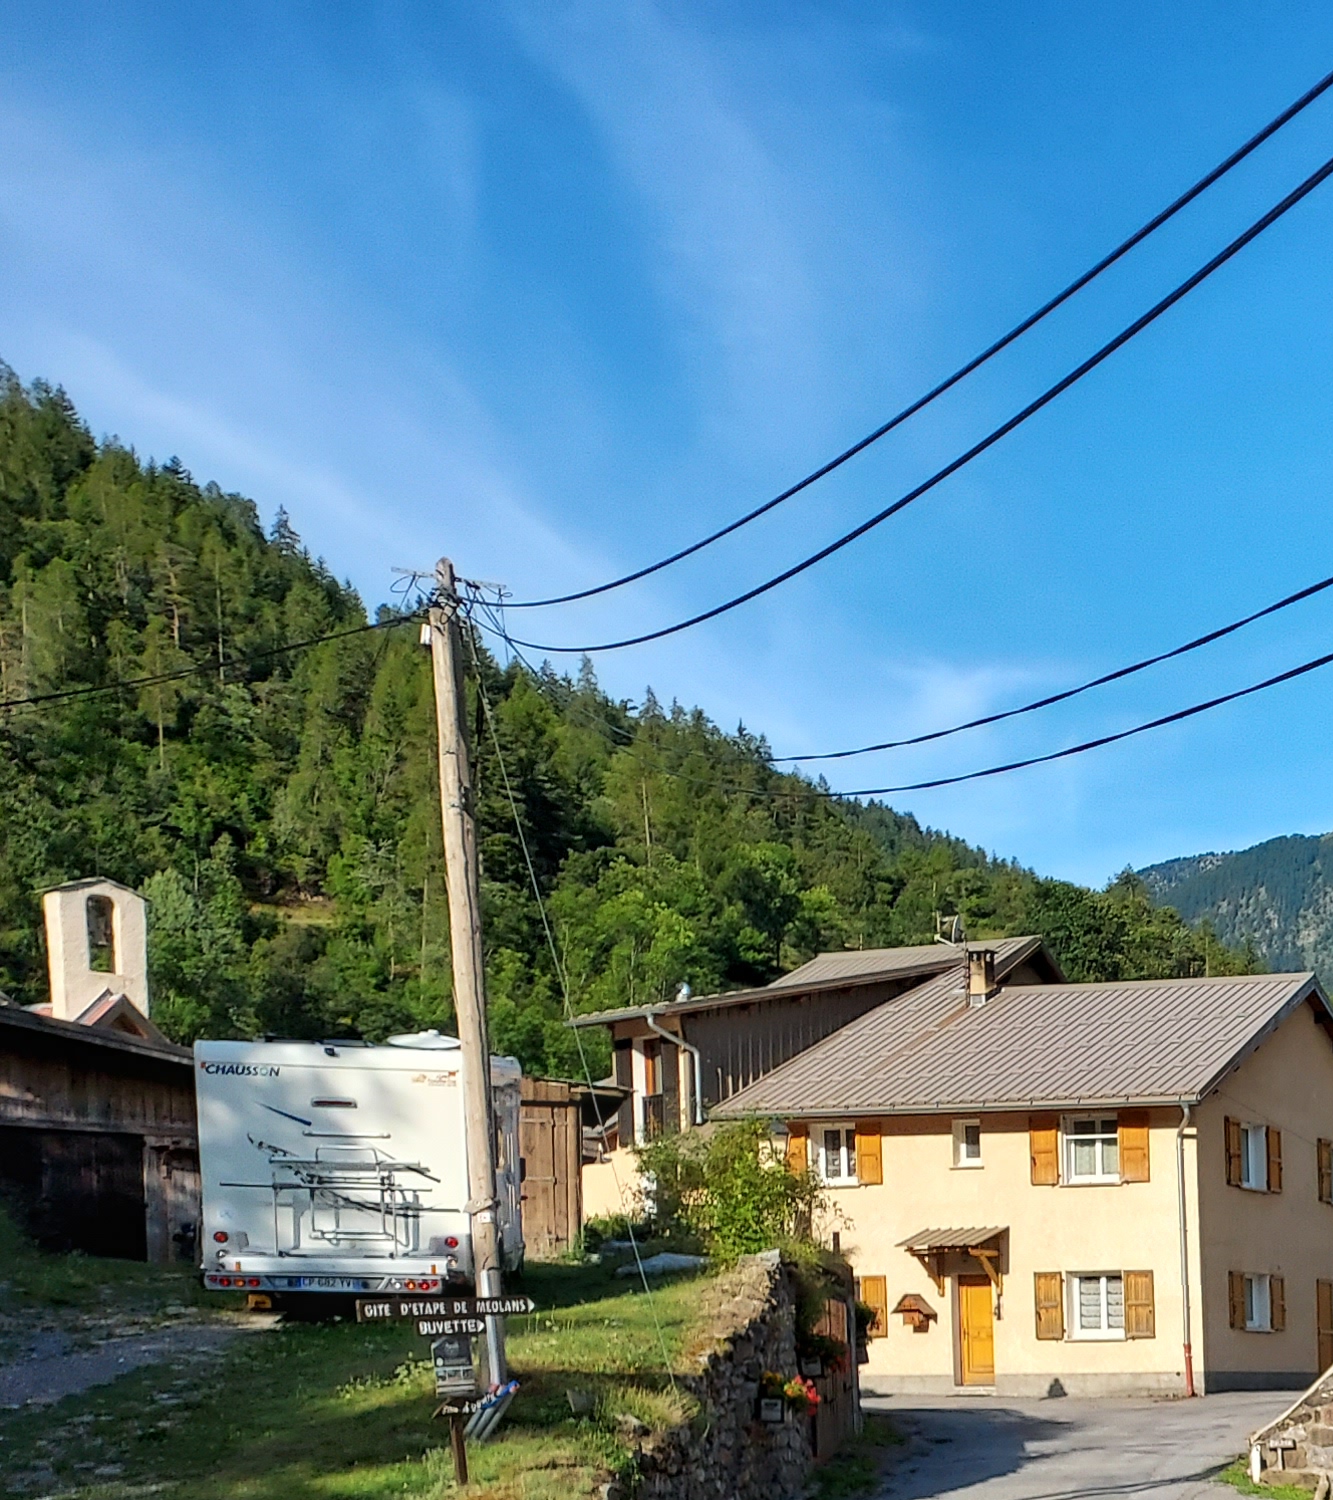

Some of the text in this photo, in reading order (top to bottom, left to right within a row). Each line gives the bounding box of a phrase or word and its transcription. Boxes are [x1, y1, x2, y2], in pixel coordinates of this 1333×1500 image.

[205, 1063, 280, 1077] CHAUSSON
[364, 1303, 391, 1318] GITE
[400, 1302, 446, 1316] D'ETAPE
[454, 1301, 468, 1314] DE
